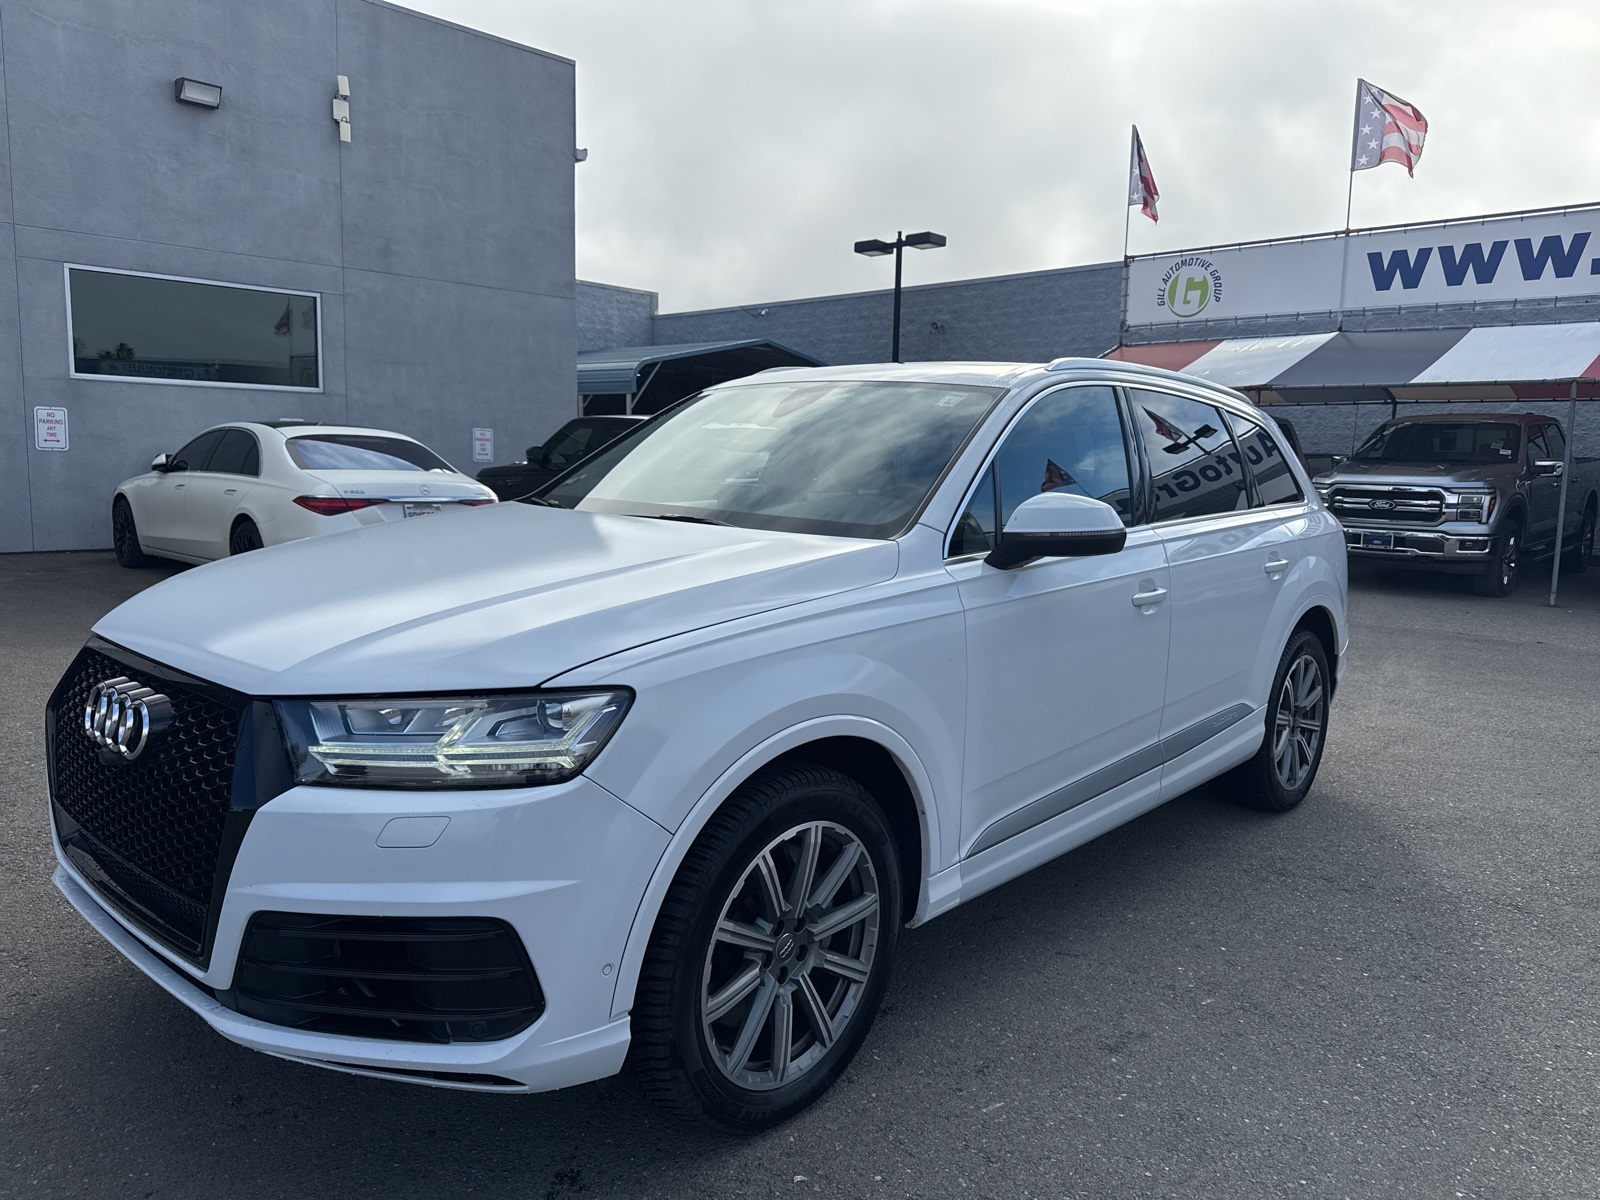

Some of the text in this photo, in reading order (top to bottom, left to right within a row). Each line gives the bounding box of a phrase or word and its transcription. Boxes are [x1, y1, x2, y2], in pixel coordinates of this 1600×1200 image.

[1157, 257, 1222, 306] GILL AUTOMOTIVE GROUP
[38, 418, 64, 426] PARKING
